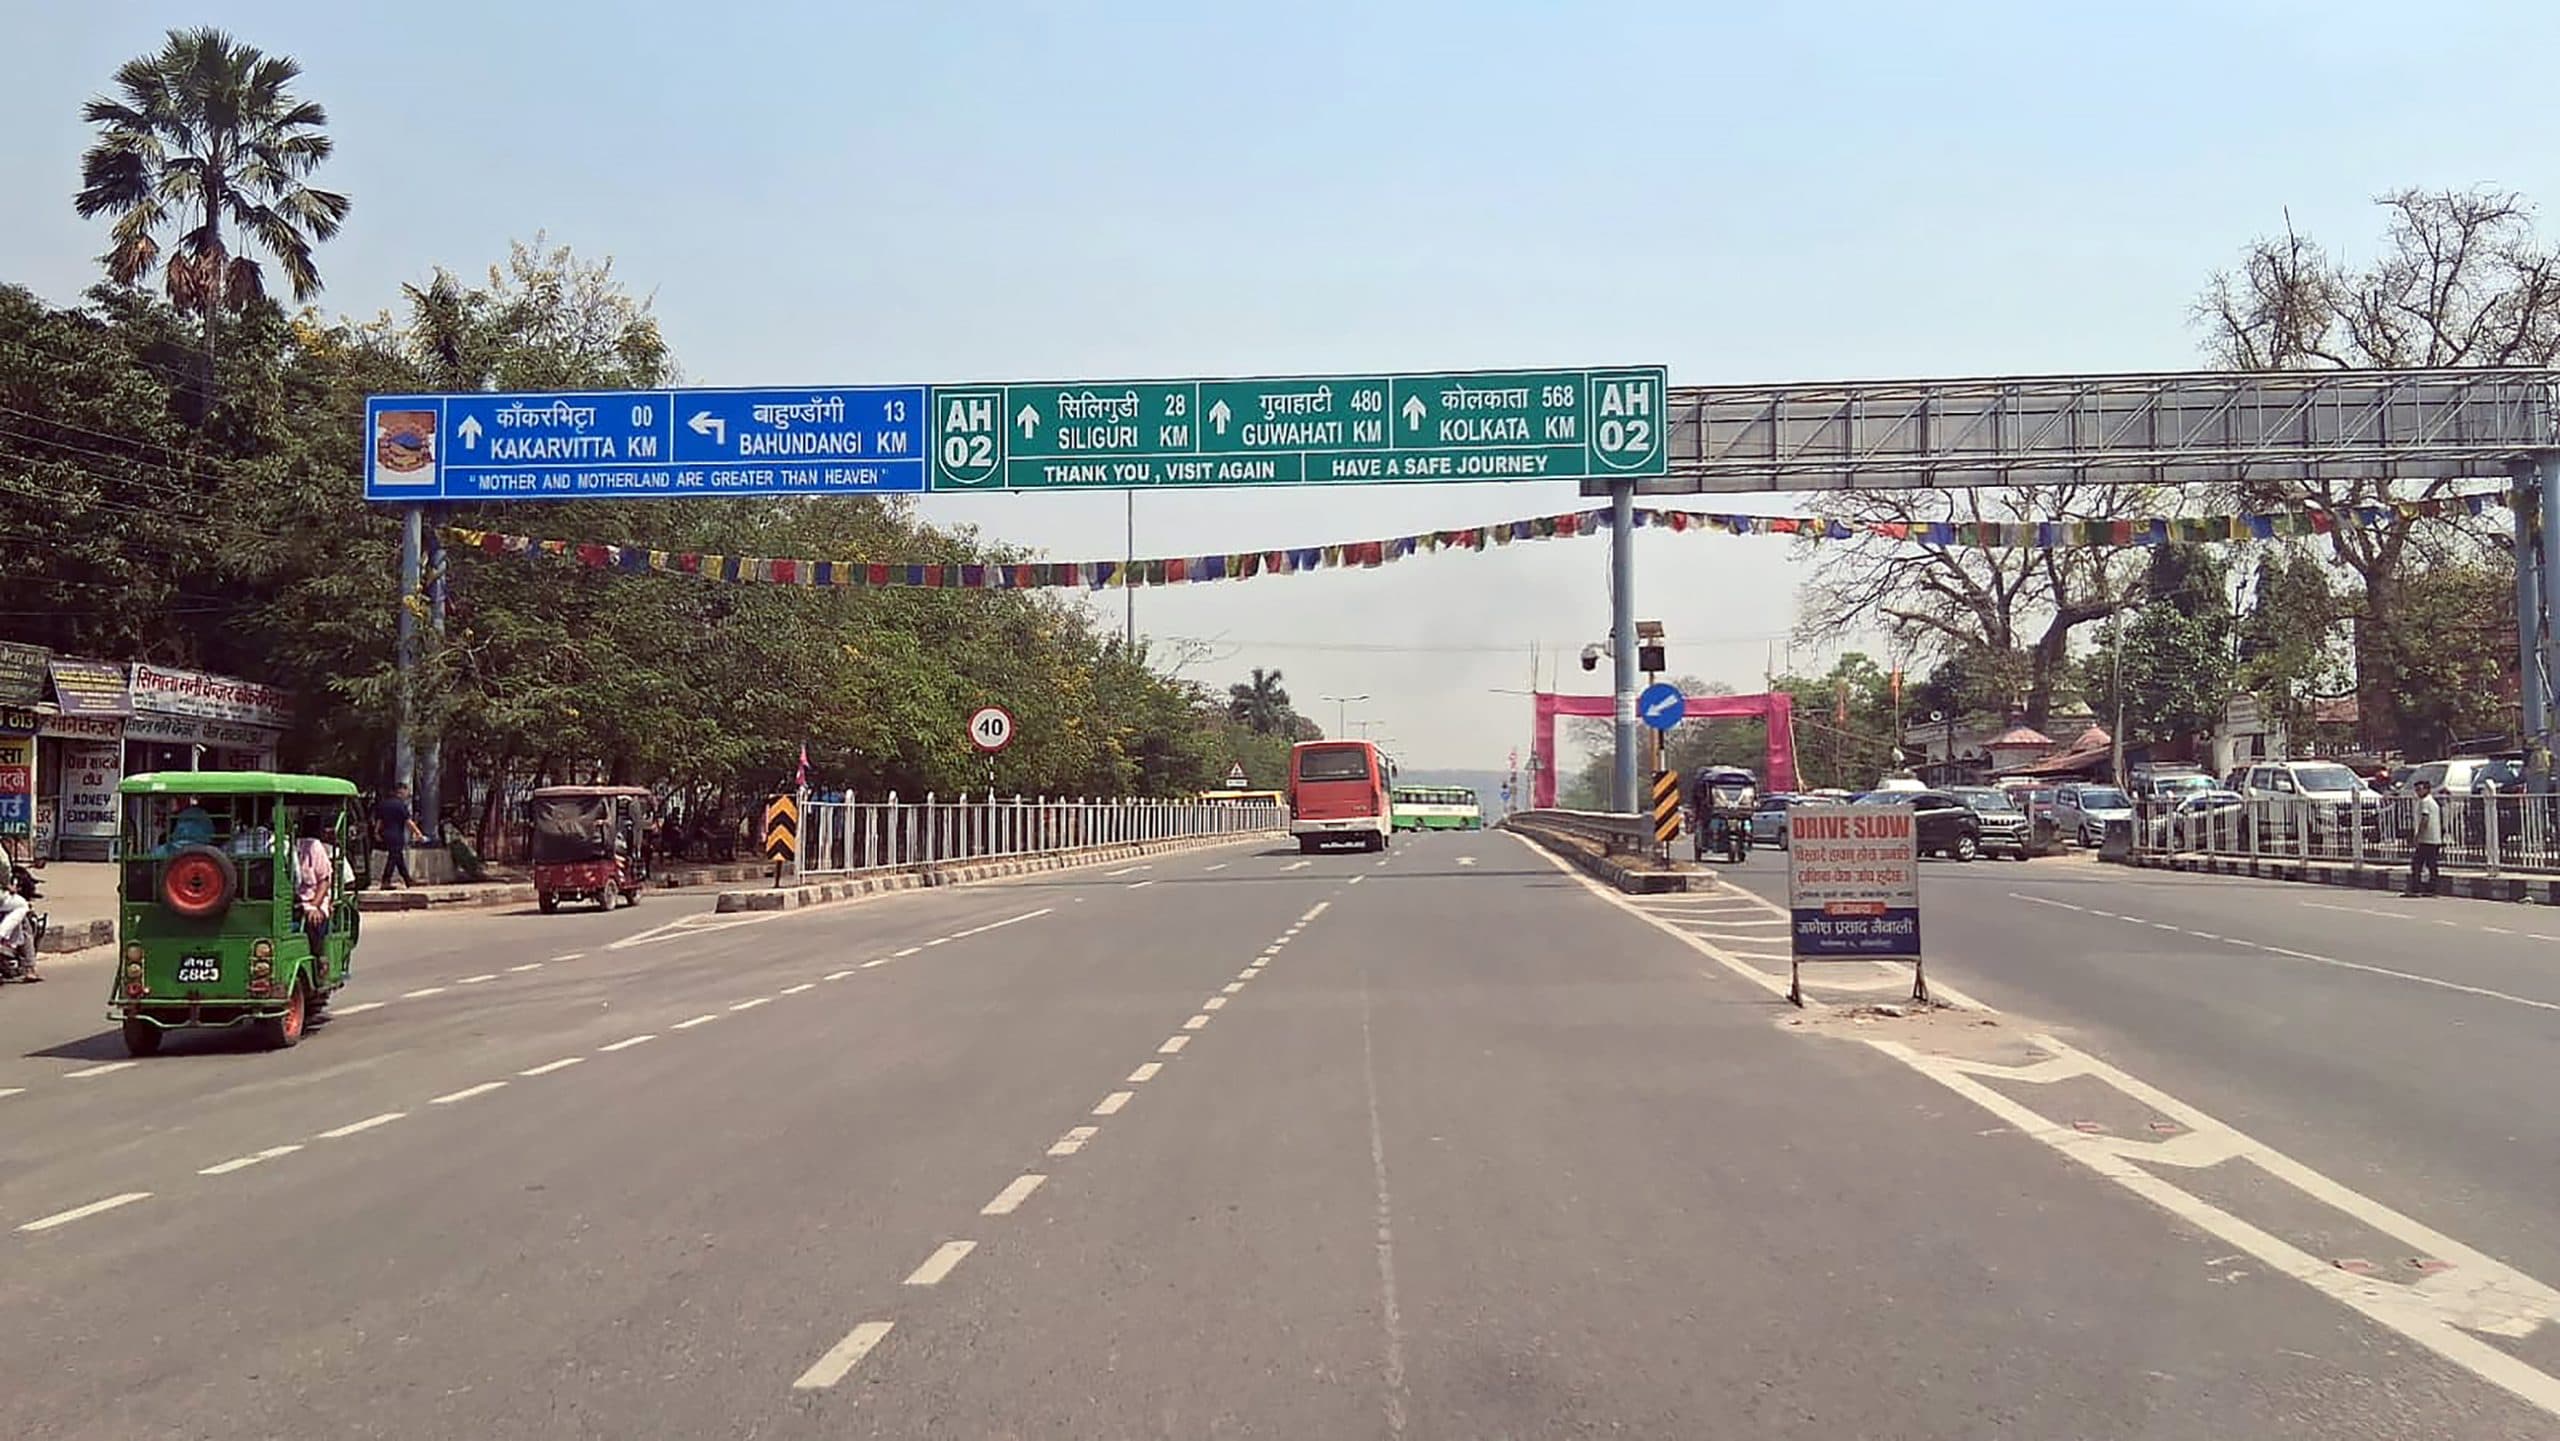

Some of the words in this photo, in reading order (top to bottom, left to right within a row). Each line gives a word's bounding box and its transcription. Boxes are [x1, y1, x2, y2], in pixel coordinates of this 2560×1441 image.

[1165, 394, 1186, 416] 28
[1259, 384, 1333, 420] गुवाहाटी
[1351, 390, 1382, 412] 480
[1440, 383, 1529, 410] कोलकाता
[1542, 385, 1575, 408] 568
[1600, 382, 1649, 416] AH
[631, 405, 653, 427] 00
[753, 396, 845, 430] बाहुण्डाँगी
[884, 400, 906, 422] 13
[945, 399, 992, 432] AH
[1058, 426, 1138, 450] SILIGURI
[1160, 425, 1188, 448] KM
[1242, 422, 1342, 446] GUWAHATI
[1353, 420, 1382, 443] KM
[1440, 417, 1530, 441] KOLKATA
[1545, 416, 1575, 440] KM
[1600, 420, 1650, 452] 02
[490, 436, 616, 460] KAKARVITTA
[628, 436, 657, 458] KM
[740, 432, 862, 456] BAHUNDANGI
[877, 431, 907, 454] KM
[944, 435, 993, 468] 02
[1044, 465, 1108, 483] THANK
[1166, 462, 1213, 480] VISIT
[1218, 461, 1275, 480] AGAIN
[1332, 459, 1382, 477] HAVE
[1386, 459, 1399, 475] A
[1404, 456, 1451, 476] SAFE
[1457, 455, 1548, 474] JOURNEY
[542, 473, 571, 489] AND
[578, 472, 670, 490] MOTHERLAND
[676, 471, 704, 488] ARE
[711, 470, 774, 487] GREATER
[781, 469, 817, 486] THAN
[978, 718, 1004, 737] 40
[1792, 816, 1850, 840] DRIVE
[1854, 815, 1910, 839] SLOW
